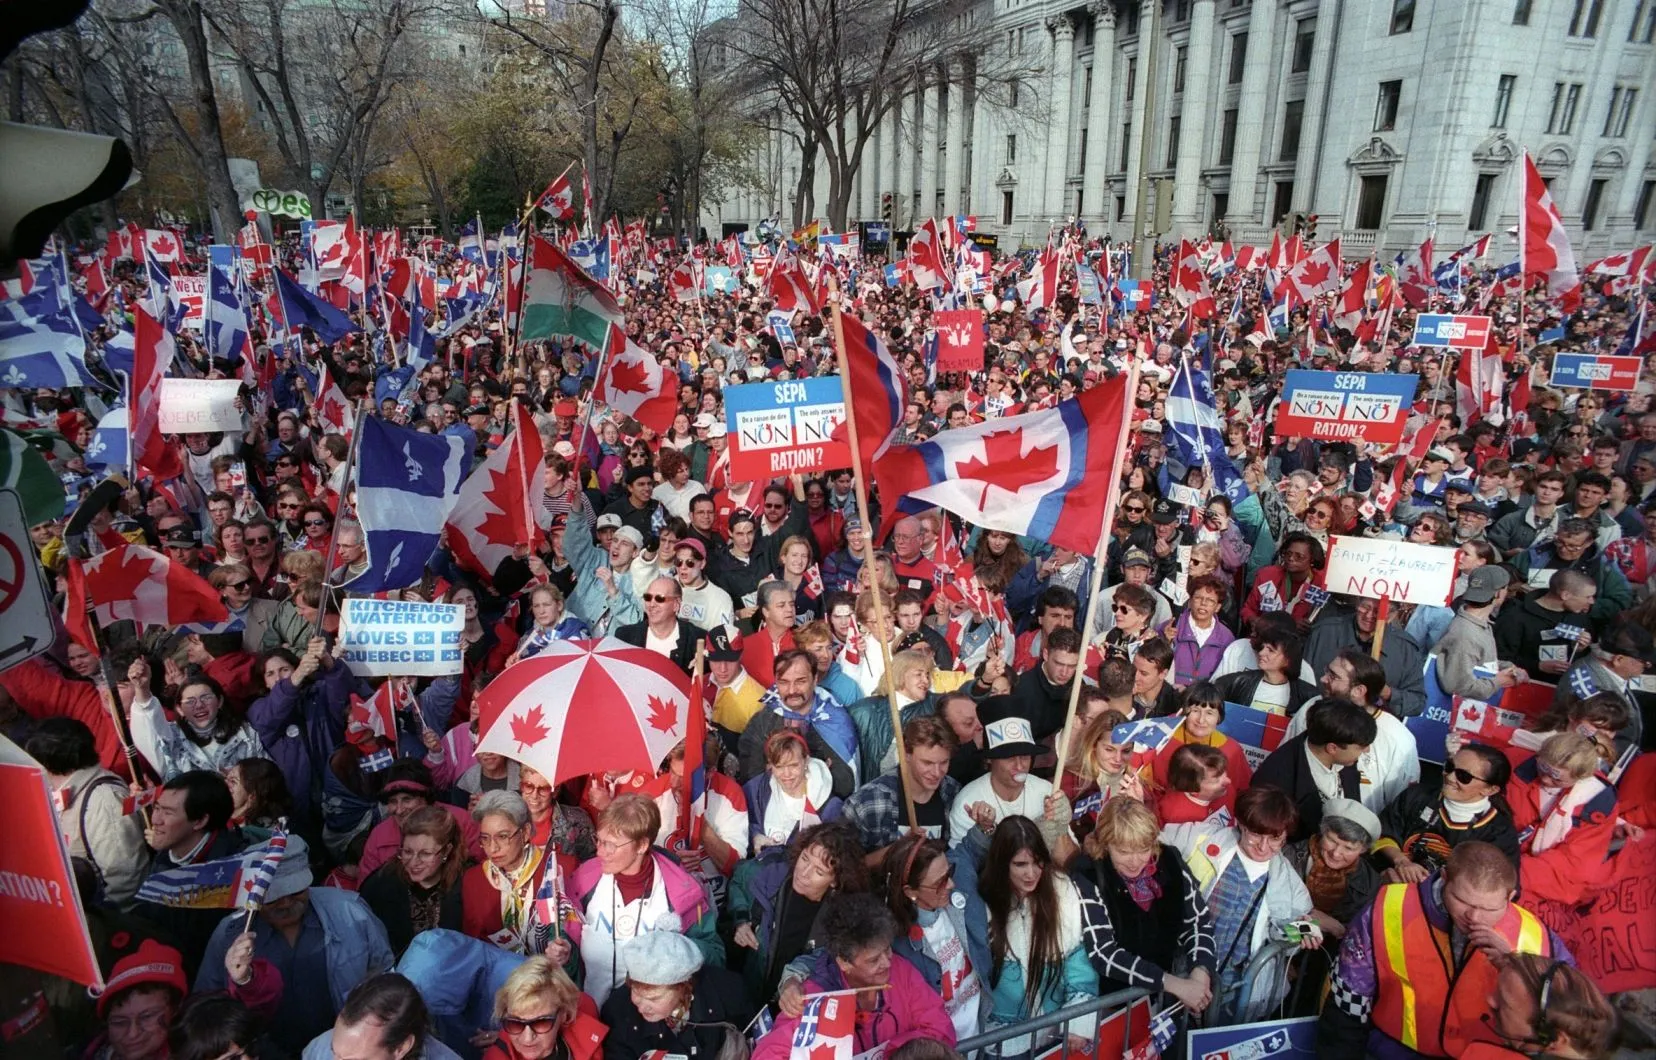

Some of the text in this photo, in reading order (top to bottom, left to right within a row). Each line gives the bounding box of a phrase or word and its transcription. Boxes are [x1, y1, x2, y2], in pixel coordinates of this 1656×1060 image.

[175, 281, 207, 293] We Lo
[1334, 374, 1367, 390] SÉPA
[774, 382, 807, 404] SÉPA
[1293, 400, 1339, 416] NON
[1352, 402, 1390, 421] NO
[743, 421, 789, 447] NON
[805, 414, 840, 442] NO
[1332, 548, 1376, 563] SAINT
[1347, 576, 1410, 600] NON
[350, 601, 457, 614] KITCHENER
[681, 601, 706, 619] ON
[351, 612, 455, 624] WATERLOO
[346, 631, 408, 645] LOVES
[344, 651, 411, 662] QUEBEC
[0, 870, 64, 908] ATION?
